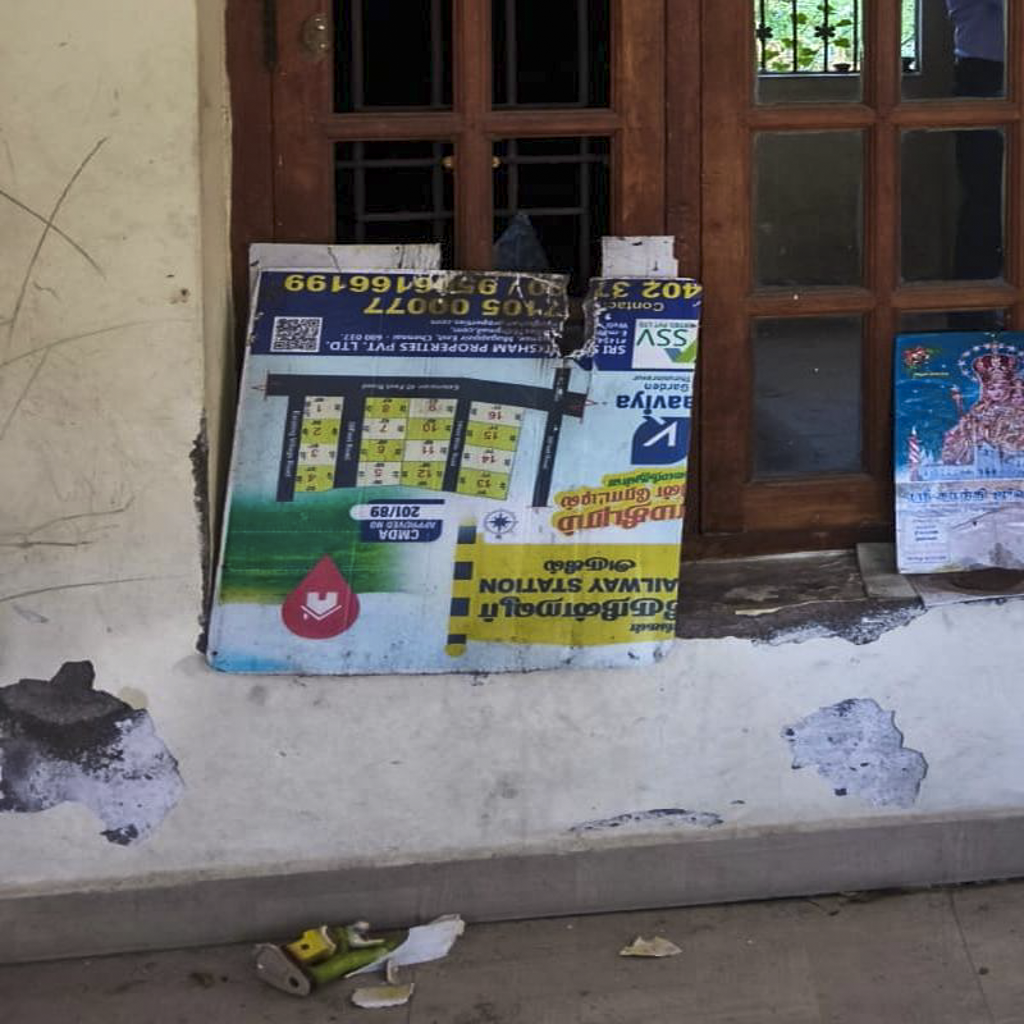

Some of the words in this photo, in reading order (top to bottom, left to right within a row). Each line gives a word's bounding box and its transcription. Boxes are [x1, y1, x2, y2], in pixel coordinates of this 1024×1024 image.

[641, 281, 702, 299] 402
[363, 297, 470, 315] 00077
[606, 302, 664, 312] Contac
[636, 329, 688, 347] SSV
[326, 340, 358, 351] LTD.
[363, 341, 395, 352] PVT.
[399, 342, 488, 353] PROPERTIES
[603, 344, 627, 355] SRI
[644, 383, 689, 392] Garden
[616, 391, 693, 415] aaviya
[369, 506, 421, 517] 201/89
[378, 529, 420, 540] CMDA
[543, 557, 636, 574] அருகில்
[479, 578, 583, 594] STATION
[587, 578, 678, 593] AILWAY
